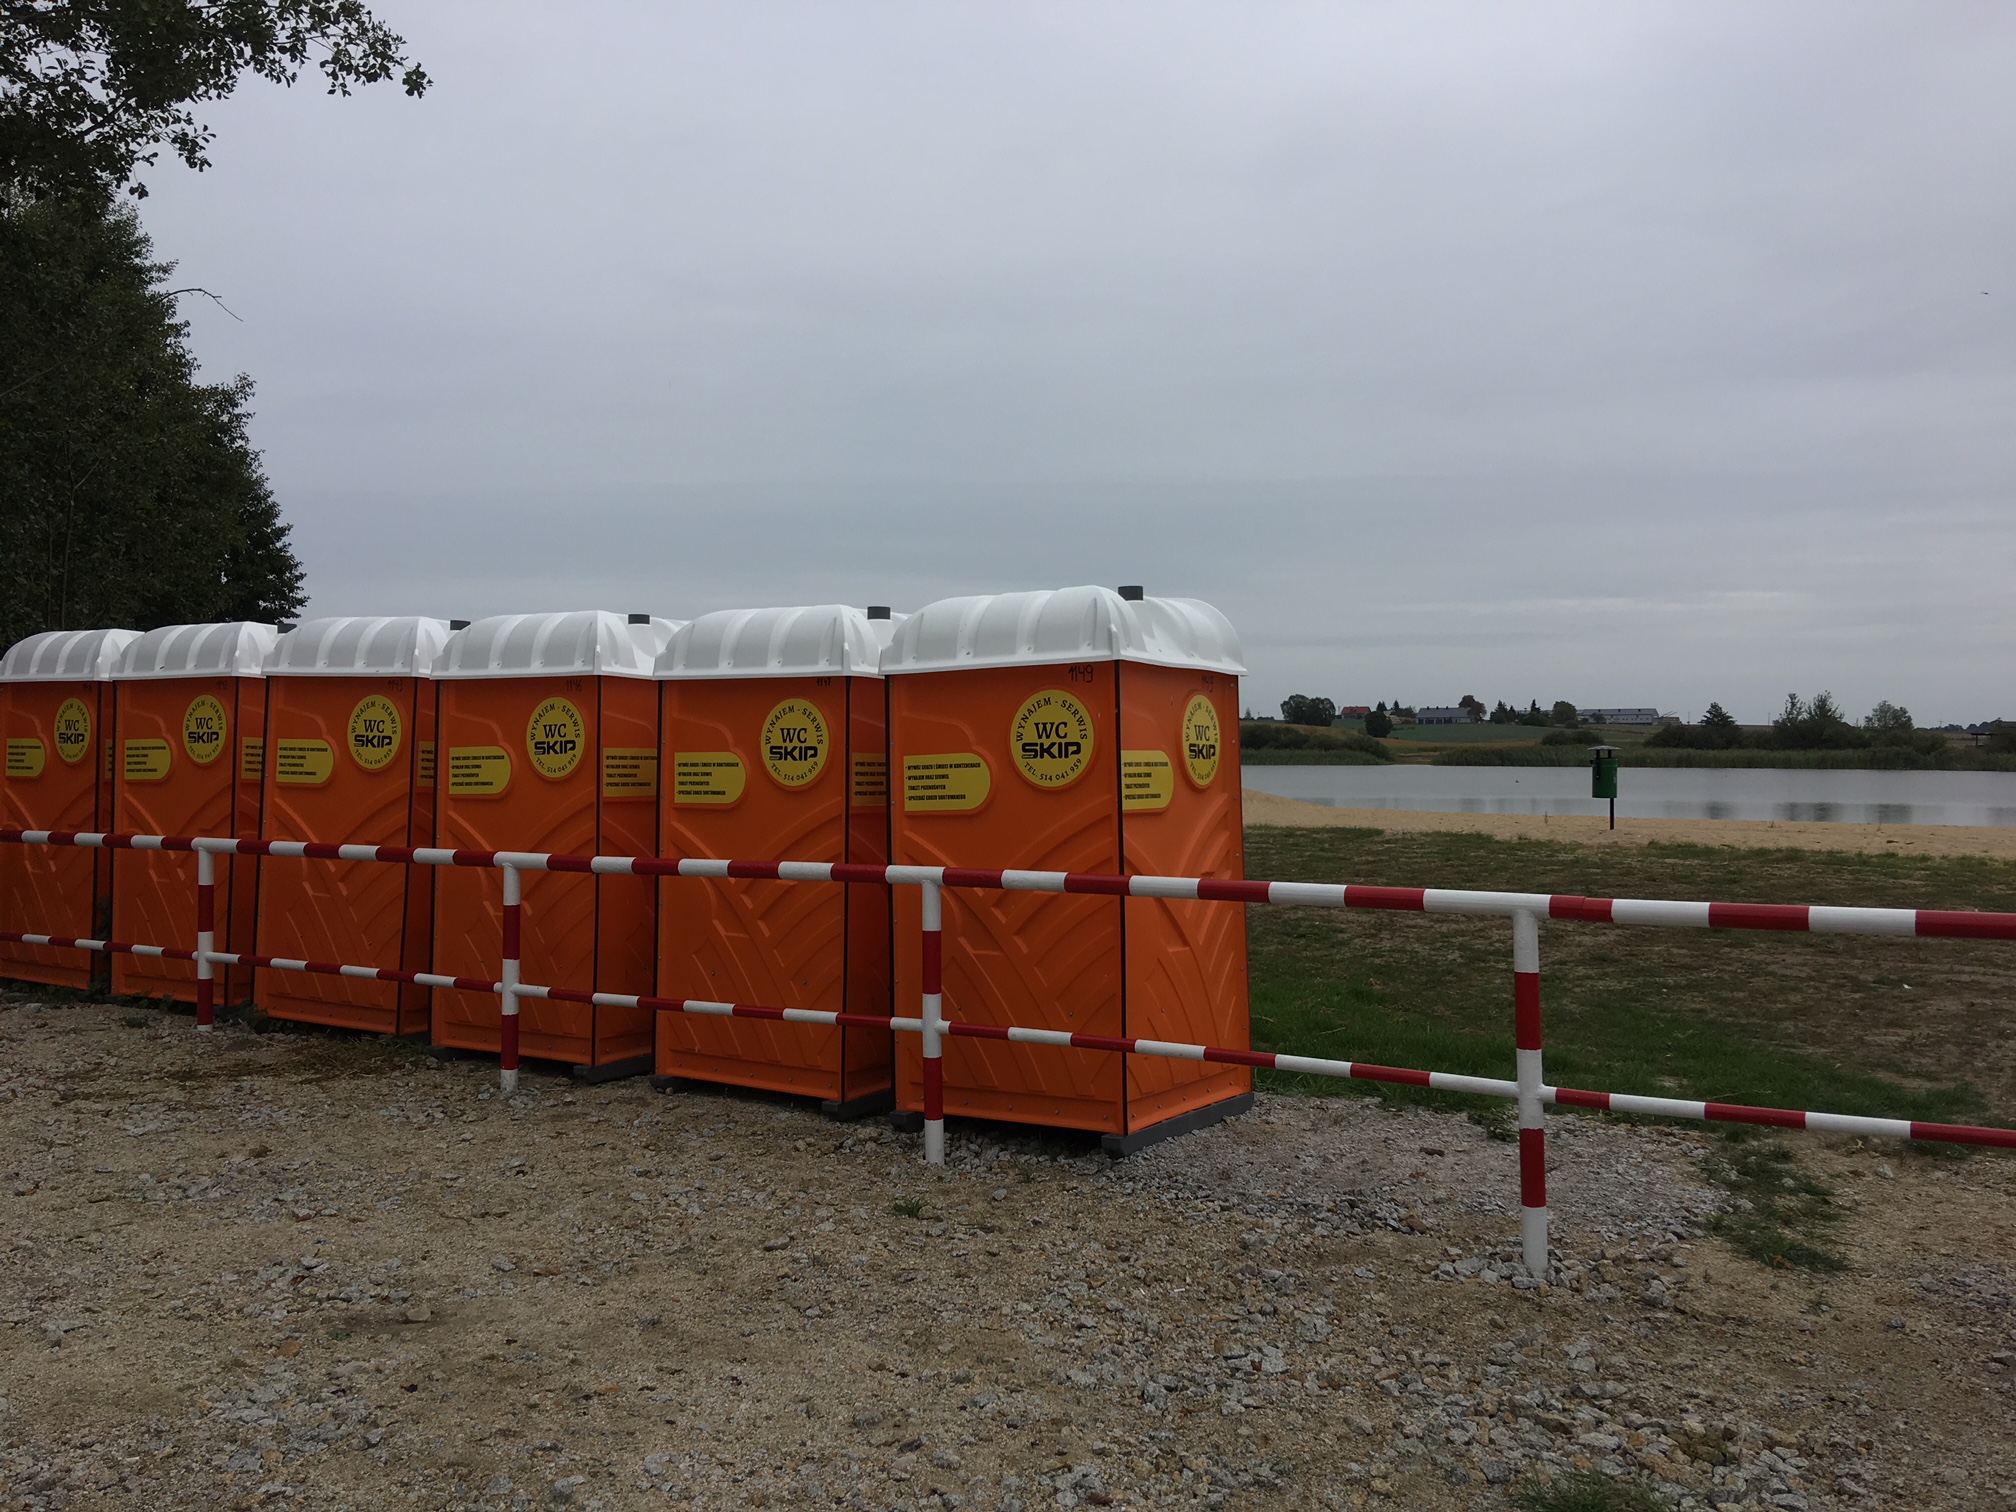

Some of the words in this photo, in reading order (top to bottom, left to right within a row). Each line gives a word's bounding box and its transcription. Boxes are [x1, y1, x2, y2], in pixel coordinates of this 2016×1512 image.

[1068, 664, 1094, 682] 1149
[195, 717, 212, 730] WC
[351, 700, 376, 734] WYNAJEM
[381, 703, 397, 735] SERWIS
[530, 703, 556, 741] WYNAJEM
[561, 705, 580, 738] SERWIS
[765, 705, 795, 745] WYNAJEM
[802, 708, 823, 745] SERWIS
[1016, 697, 1052, 742] WYNAJEM
[1060, 700, 1087, 740] SERWIS
[65, 720, 79, 732] WC
[363, 719, 385, 733] WC
[543, 723, 566, 738] WC
[1034, 722, 1068, 740] WC
[1194, 725, 1210, 741] WC
[58, 732, 84, 744] SKIP
[188, 732, 219, 743] SKIP
[354, 734, 392, 748] SKIP
[780, 728, 807, 743] WC
[534, 740, 576, 755] SKIP
[769, 746, 818, 761] SKIP
[1022, 742, 1081, 759] SKIP
[1189, 743, 1216, 760] SKIP
[796, 772, 808, 780] 041
[808, 761, 818, 774] 959
[1024, 762, 1038, 777] TEL.
[1040, 774, 1053, 782] 514
[1056, 771, 1069, 780] 041
[1070, 758, 1082, 773] 959
